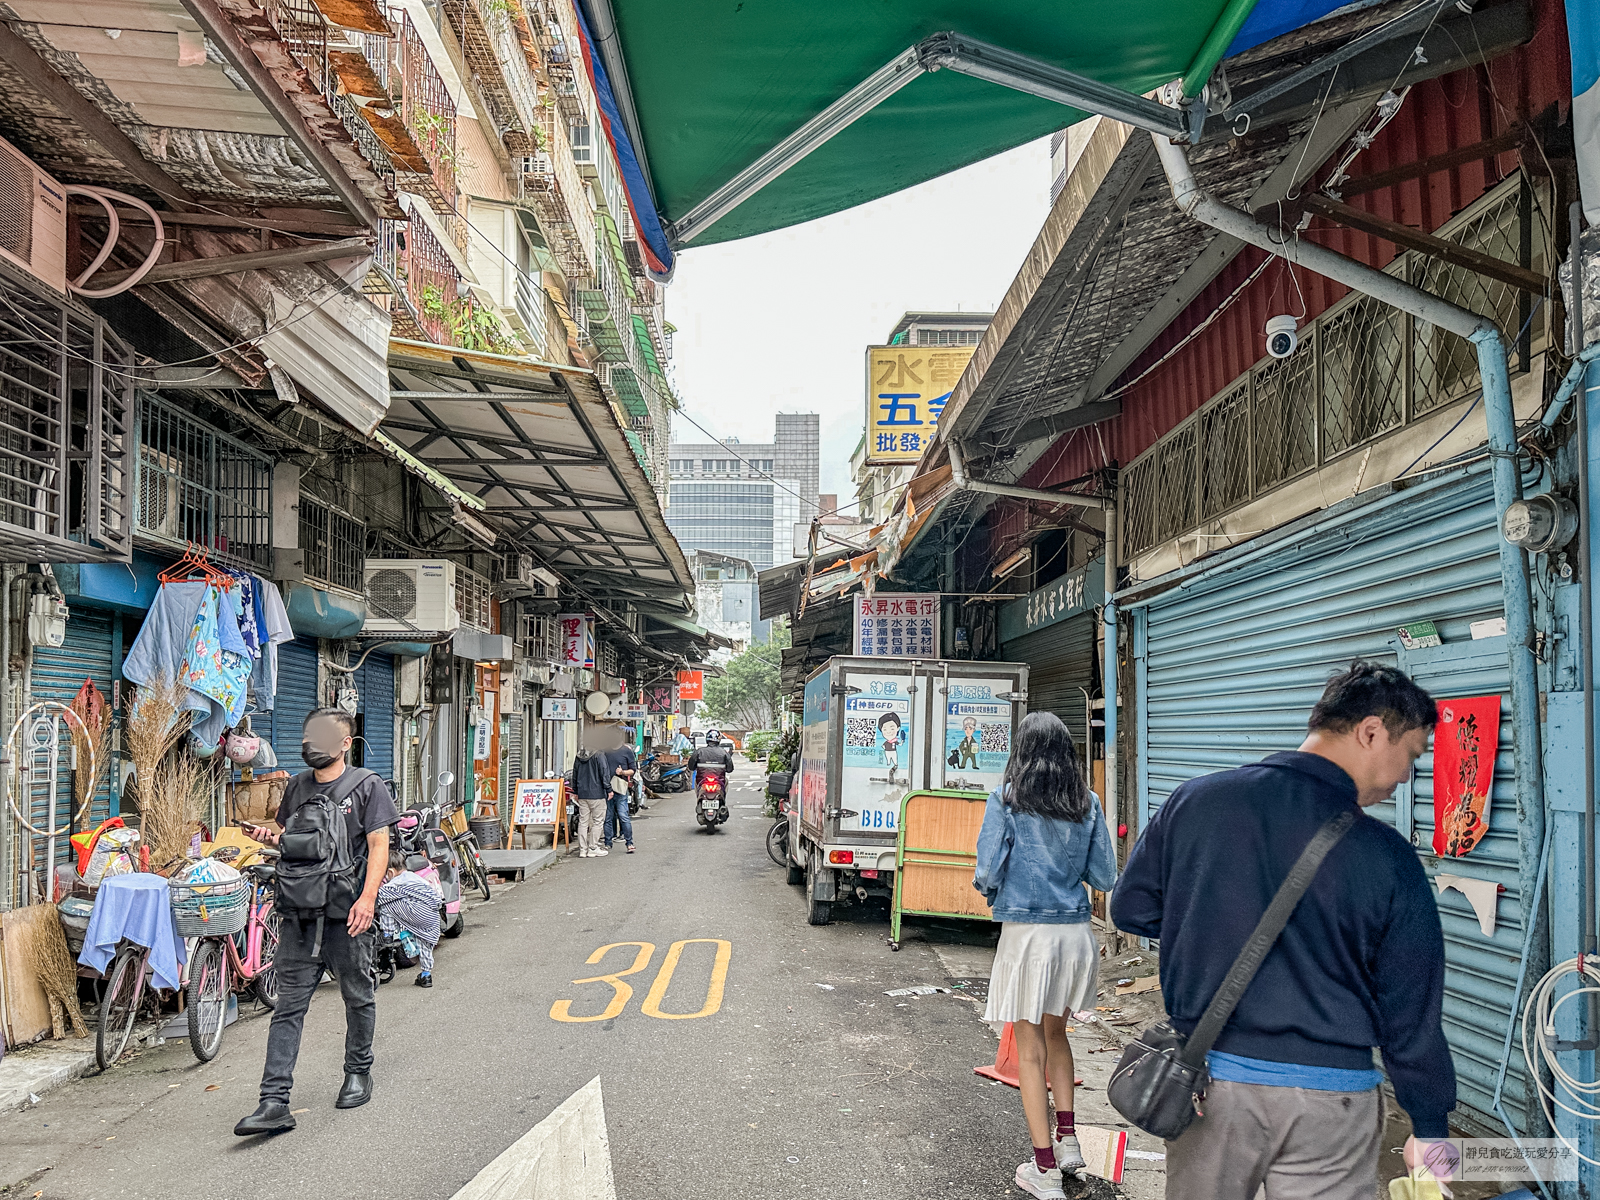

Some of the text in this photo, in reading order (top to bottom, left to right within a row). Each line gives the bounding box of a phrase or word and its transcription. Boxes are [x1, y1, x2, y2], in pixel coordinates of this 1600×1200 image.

[38, 178, 63, 202] Panasonic
[861, 599, 933, 616] 永昇水電行
[905, 618, 918, 656] 水電工程
[920, 618, 933, 656] 水電材料
[861, 809, 896, 829] BBQ
[549, 938, 732, 1023] 30
